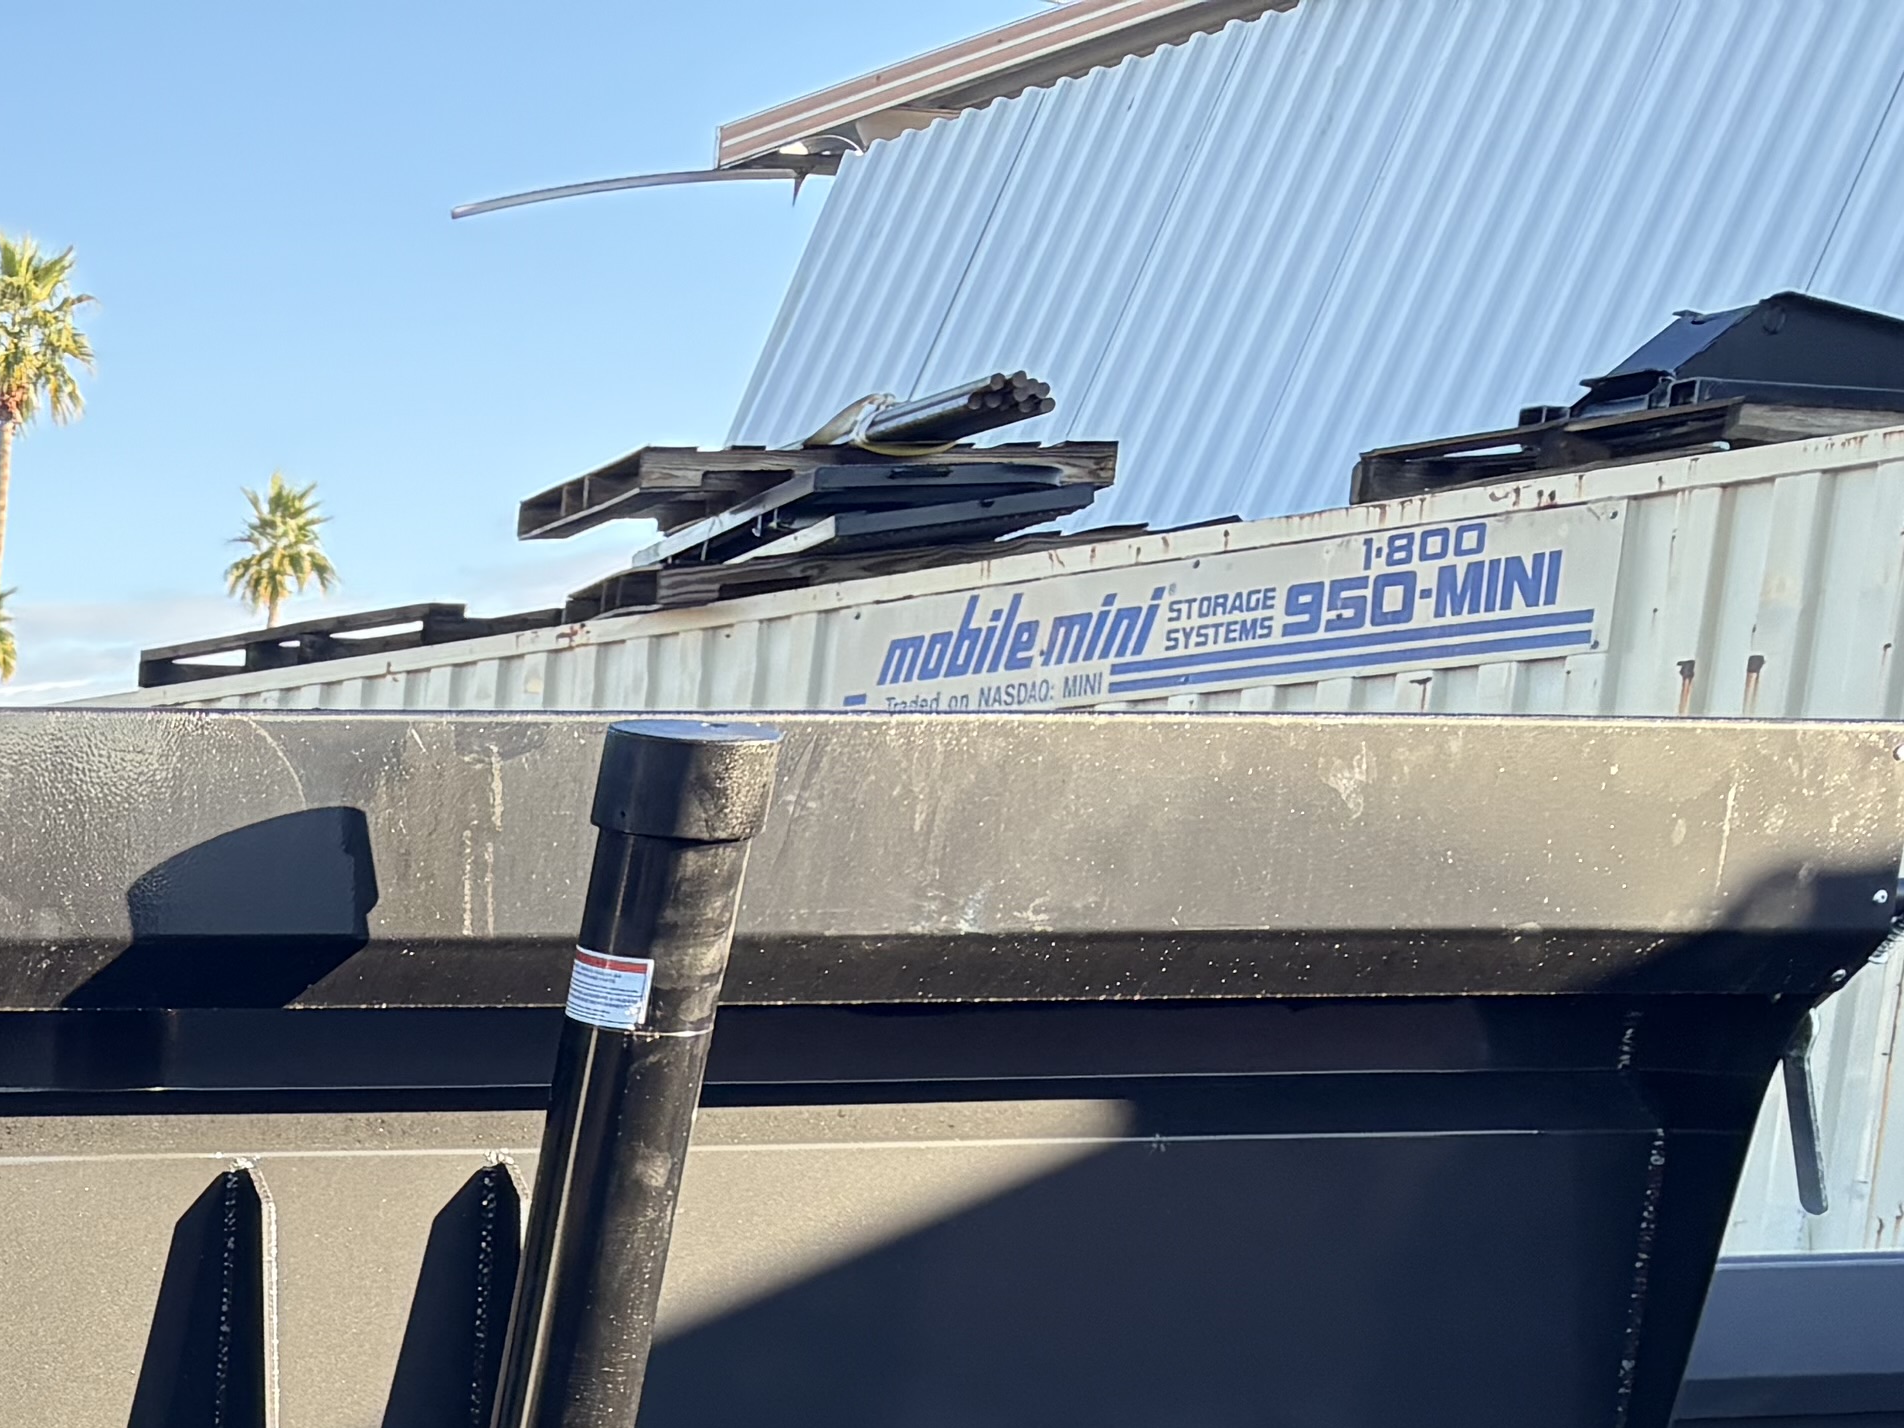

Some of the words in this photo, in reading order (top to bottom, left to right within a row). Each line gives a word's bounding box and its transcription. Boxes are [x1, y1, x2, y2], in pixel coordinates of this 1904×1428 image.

[1167, 586, 1277, 622] STORAGE
[1281, 549, 1563, 638] 950-MINI
[1164, 615, 1273, 652] SYSTEMS
[948, 694, 969, 709] on
[1062, 672, 1104, 698] MINI
